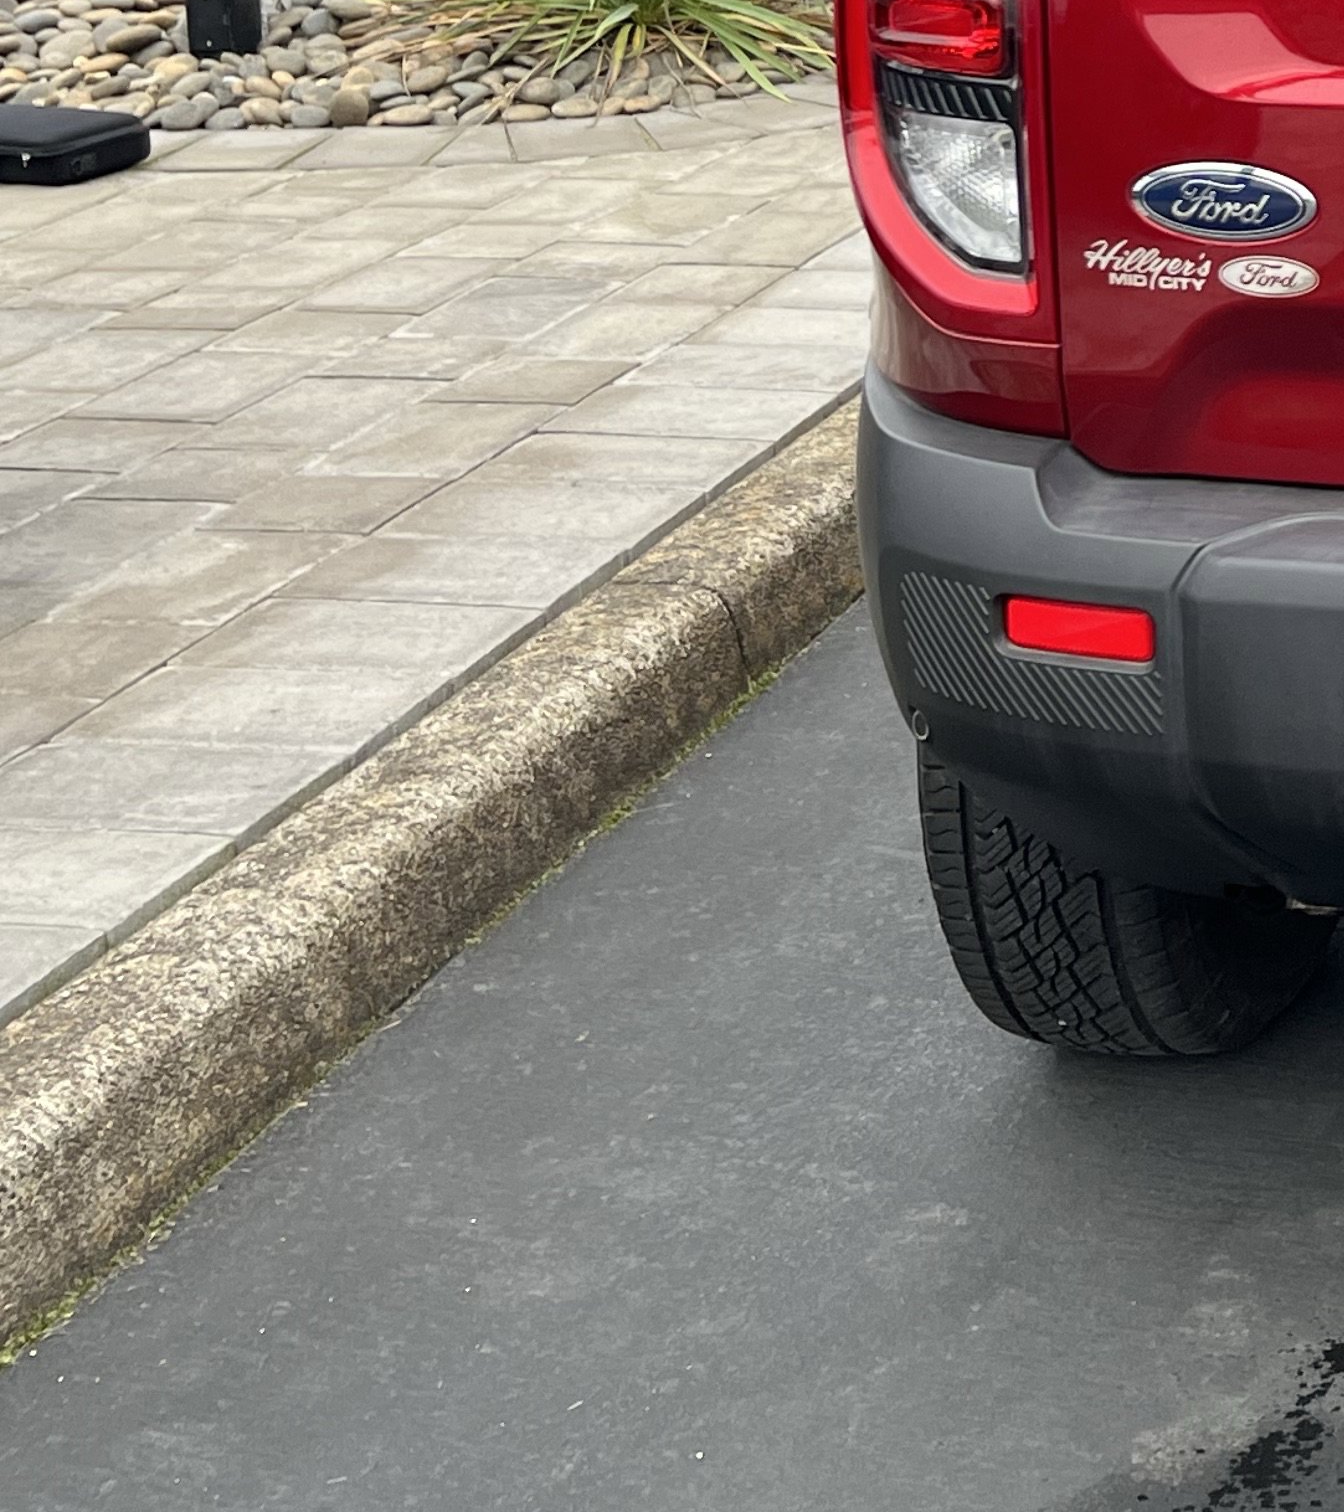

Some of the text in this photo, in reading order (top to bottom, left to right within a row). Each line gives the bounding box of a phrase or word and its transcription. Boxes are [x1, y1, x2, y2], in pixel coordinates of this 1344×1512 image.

[1171, 178, 1273, 225] Ford
[1083, 239, 1212, 290] Hillyer's
[1108, 272, 1207, 292] MID CITY
[1239, 261, 1298, 289] Ford
